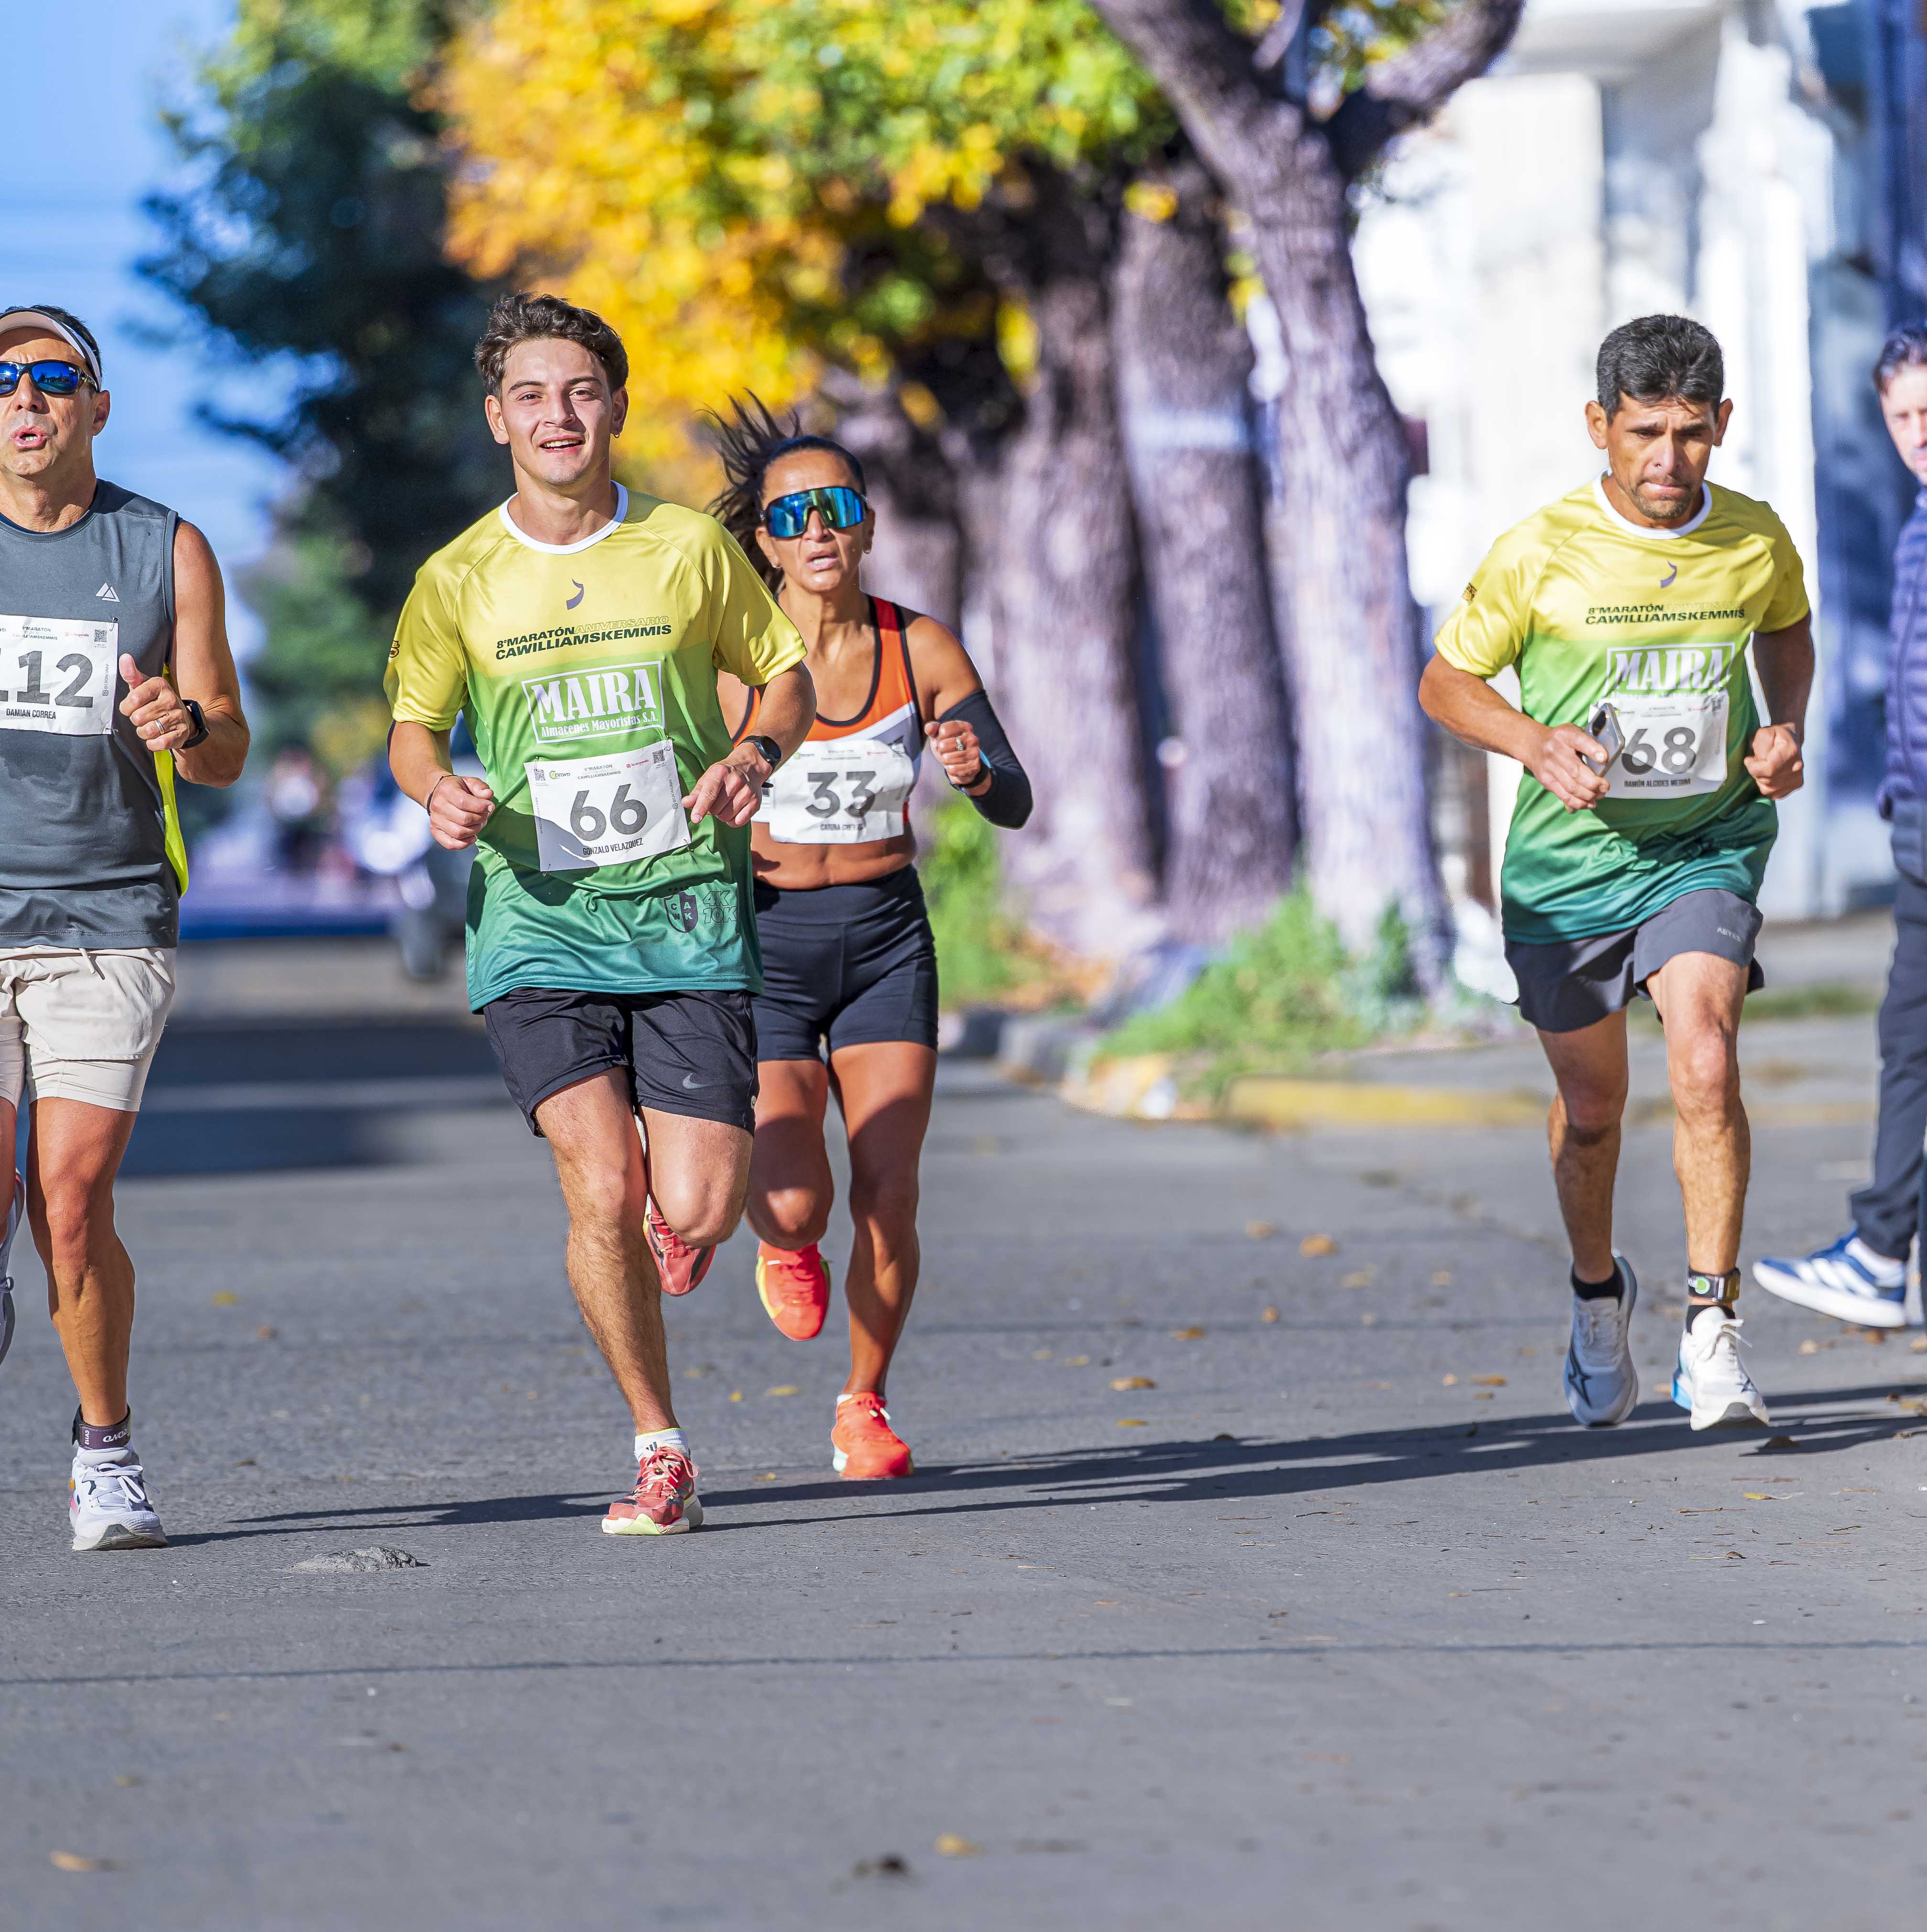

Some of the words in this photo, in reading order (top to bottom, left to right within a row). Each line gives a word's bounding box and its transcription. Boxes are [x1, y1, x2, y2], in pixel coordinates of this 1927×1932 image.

[574, 615, 669, 634] ANIVERSARIO
[1585, 608, 1744, 625] CAWILLIAMSKEMMIS
[496, 625, 671, 660] CAWILLIAMSKEMMIS
[0, 648, 93, 708] 12
[1615, 649, 1723, 691] MAIRA
[531, 669, 657, 724] MAIRA
[6, 708, 31, 717] DAMIAN
[32, 710, 56, 719] CORREA
[541, 722, 590, 737] Almacenes
[592, 715, 640, 731] Mayoristas
[642, 710, 659, 723] S.A.
[1621, 727, 1696, 776] 68
[805, 771, 877, 819] 33
[570, 783, 648, 842] 66
[583, 845, 609, 855] GONZALO
[610, 838, 644, 852] VELAZQUEZ
[683, 902, 692, 910] A
[703, 890, 730, 907] 4K
[684, 912, 693, 920] K
[703, 906, 737, 924] 10K
